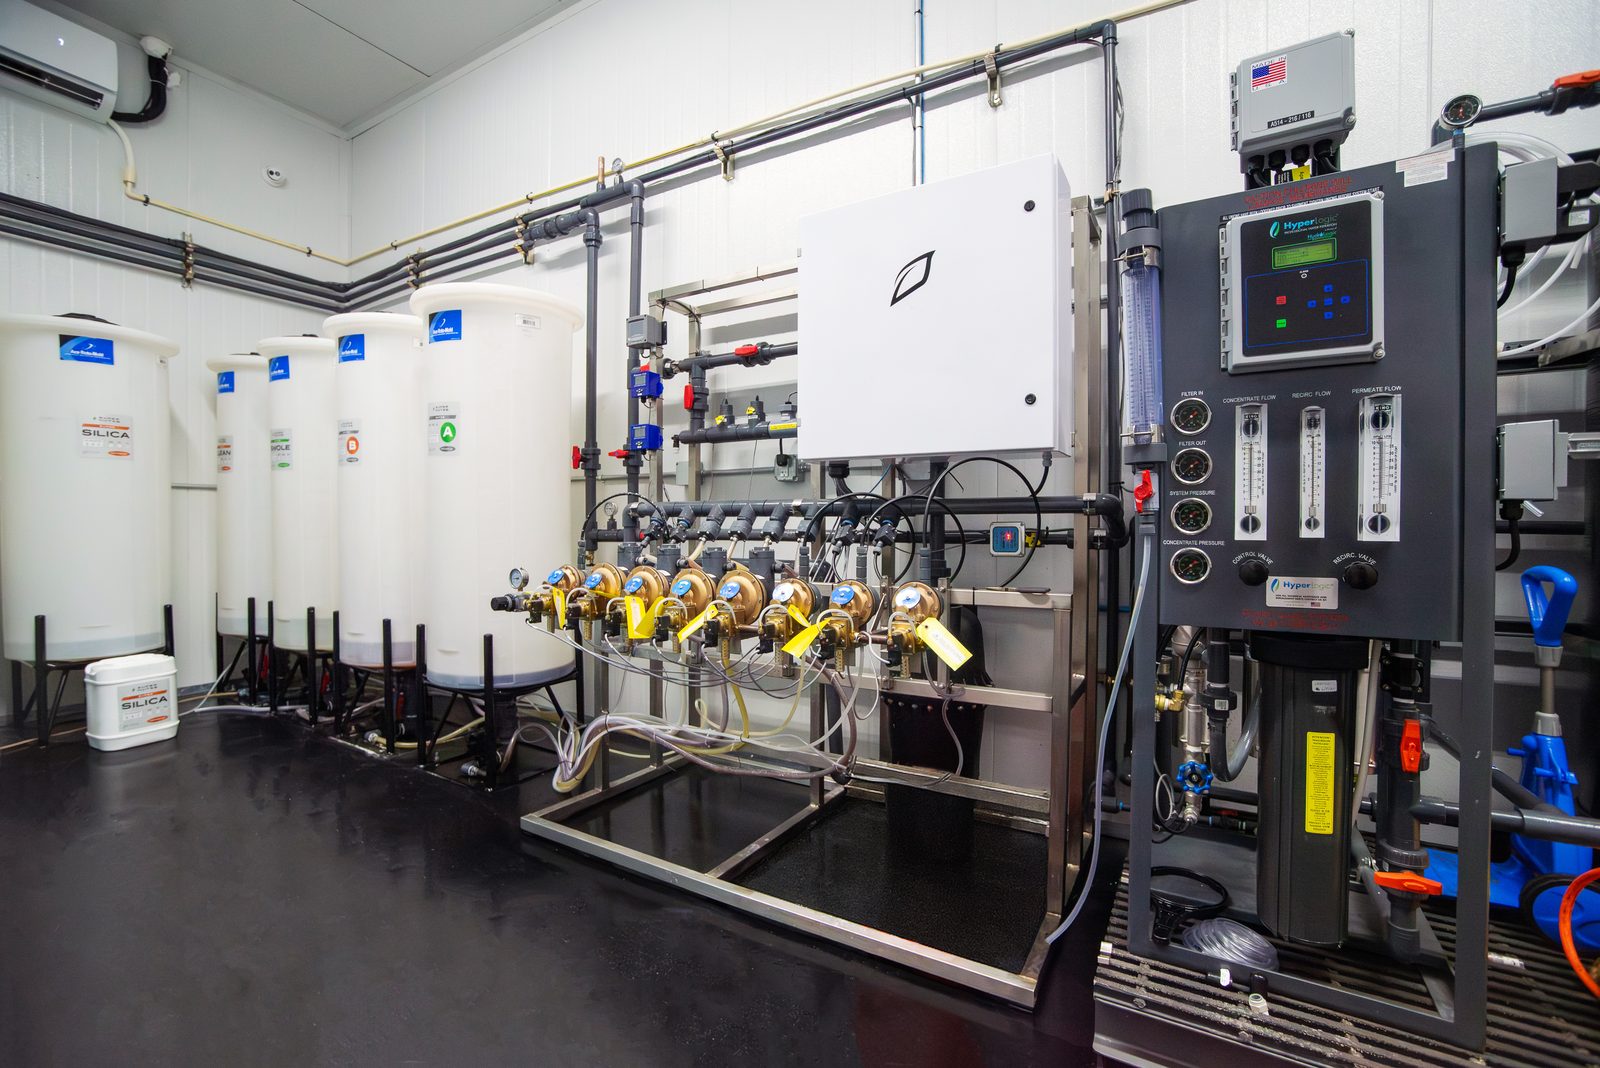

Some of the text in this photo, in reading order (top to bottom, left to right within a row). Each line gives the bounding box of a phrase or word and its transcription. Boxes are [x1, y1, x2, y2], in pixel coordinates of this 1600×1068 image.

[1252, 59, 1274, 69] MADE
[1270, 118, 1284, 128] A514
[1315, 390, 1332, 398] FLOW
[1351, 385, 1402, 395] PERMEATE FLOW
[1222, 394, 1276, 404] CONCENTRATE FLOW
[82, 429, 130, 439] SILICA
[442, 426, 453, 438] A
[348, 440, 357, 450] B
[1232, 551, 1274, 566] CONTROL VALVE
[1358, 553, 1377, 566] VALVE
[121, 695, 168, 710] SILICA
